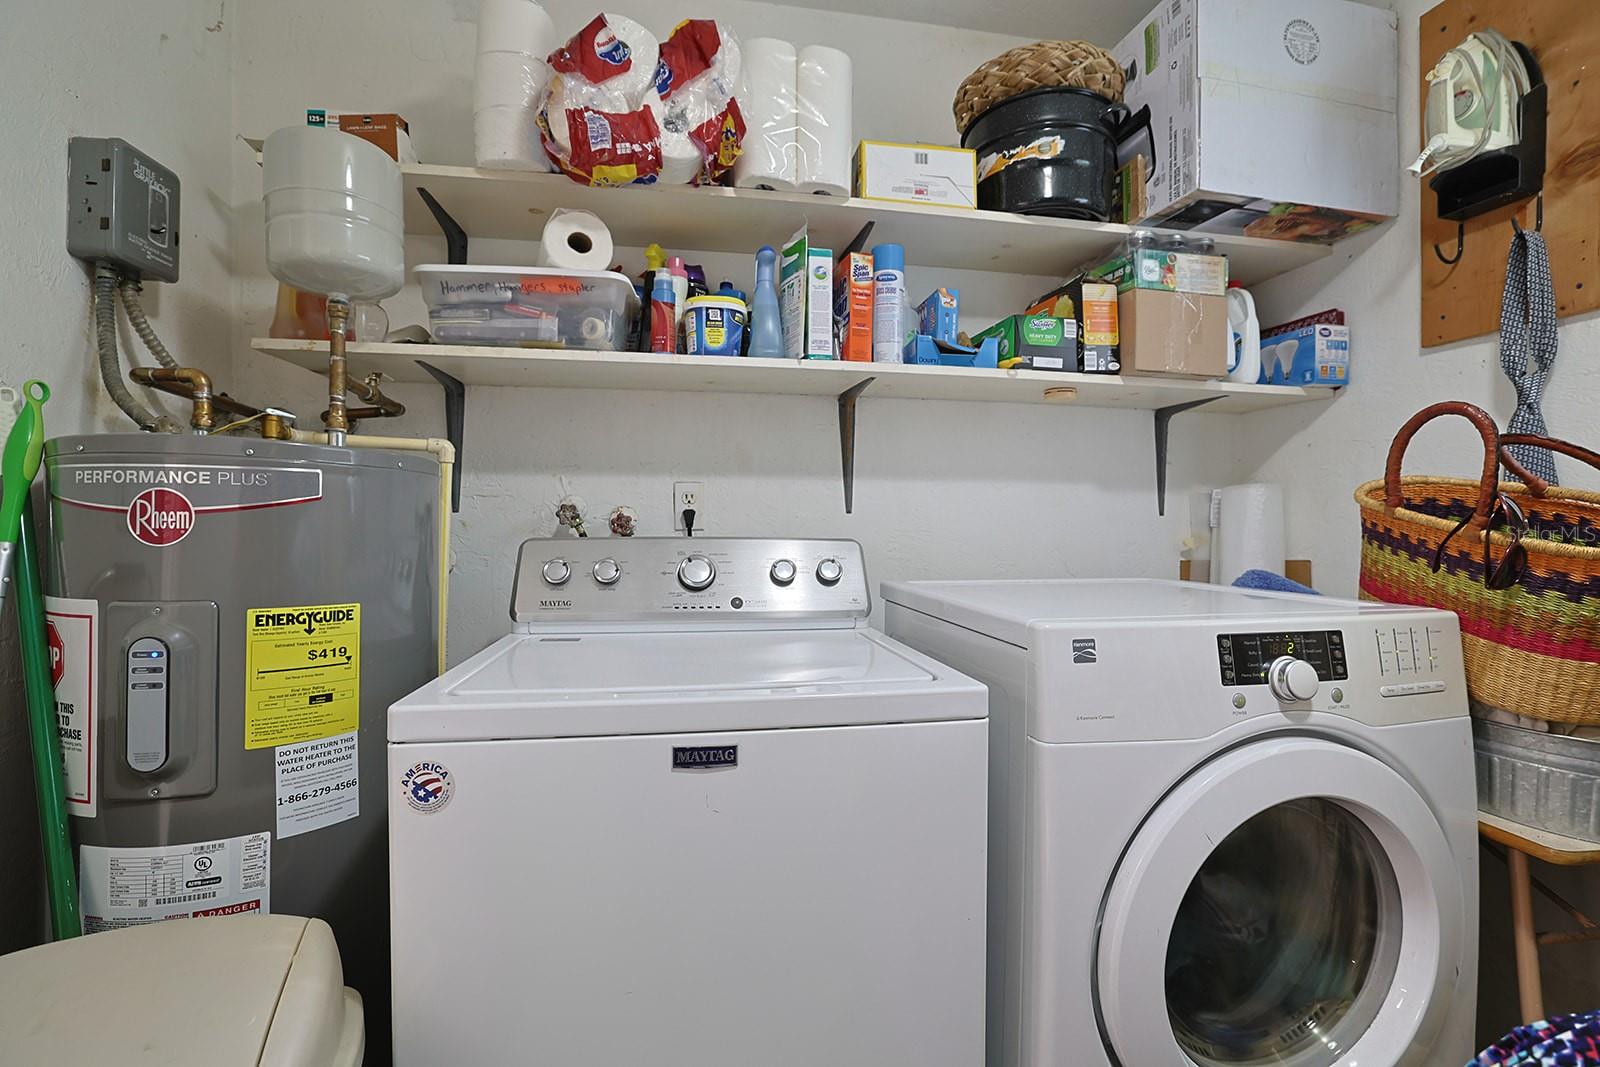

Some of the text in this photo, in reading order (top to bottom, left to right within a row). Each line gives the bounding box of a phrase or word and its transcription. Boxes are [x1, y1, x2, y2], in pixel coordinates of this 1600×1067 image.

[853, 264, 869, 272] Spic
[853, 271, 870, 279] Span
[75, 470, 211, 485] PERFORMANCE
[135, 490, 190, 537] Rheem
[307, 646, 348, 661] $419
[1287, 642, 1295, 654] 2
[60, 702, 74, 715] THIS
[61, 715, 70, 726] TO
[57, 726, 82, 741] CHASE
[279, 736, 355, 758] DO NOT RETURN THIS
[277, 743, 356, 767] WATER HEATER TO THE
[675, 749, 735, 763] MAYTAG
[281, 752, 353, 775] PLACE OF PURCHASE
[401, 762, 449, 788] AMERICA
[277, 778, 358, 807] 1-866-279-4566
[208, 902, 258, 917] DANGER
